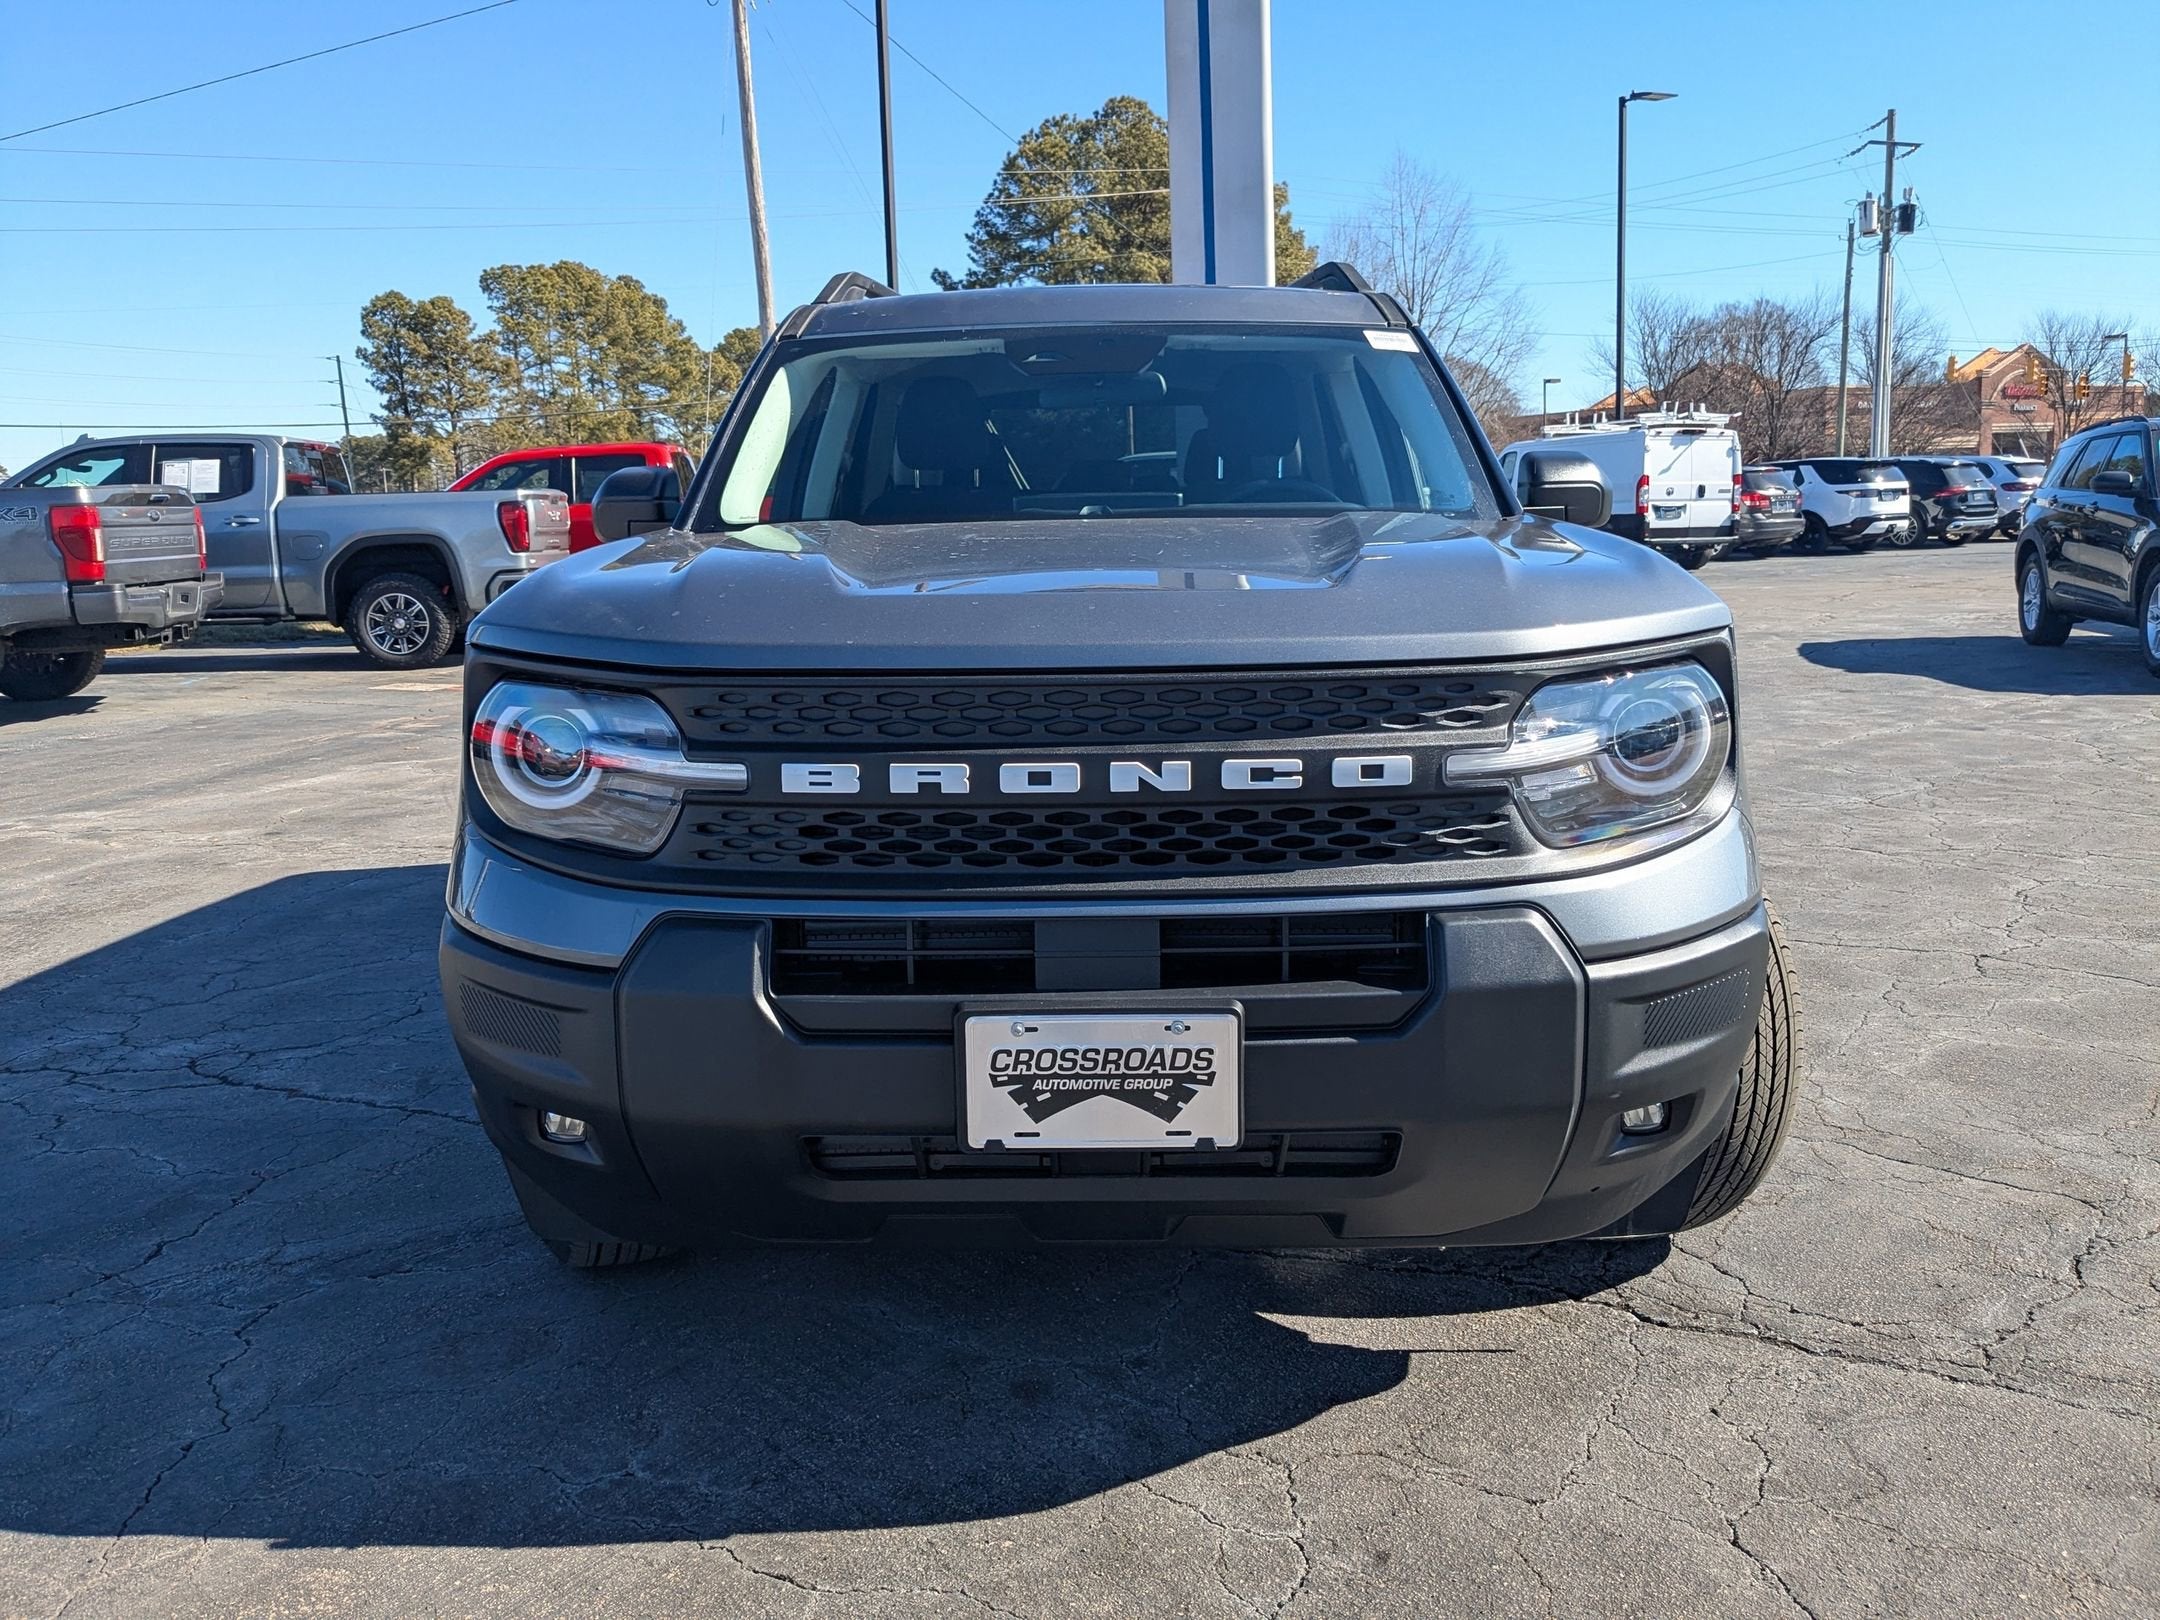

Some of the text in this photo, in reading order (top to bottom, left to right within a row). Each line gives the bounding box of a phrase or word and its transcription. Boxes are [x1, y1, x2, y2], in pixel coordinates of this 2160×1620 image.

[0, 506, 38, 521] X4
[109, 535, 193, 548] SUPER DUTY
[780, 754, 1414, 795] BRONCO
[989, 1047, 1216, 1074] CROSSROADS
[1032, 1078, 1174, 1091] AUTOMOTIVE GROUP
